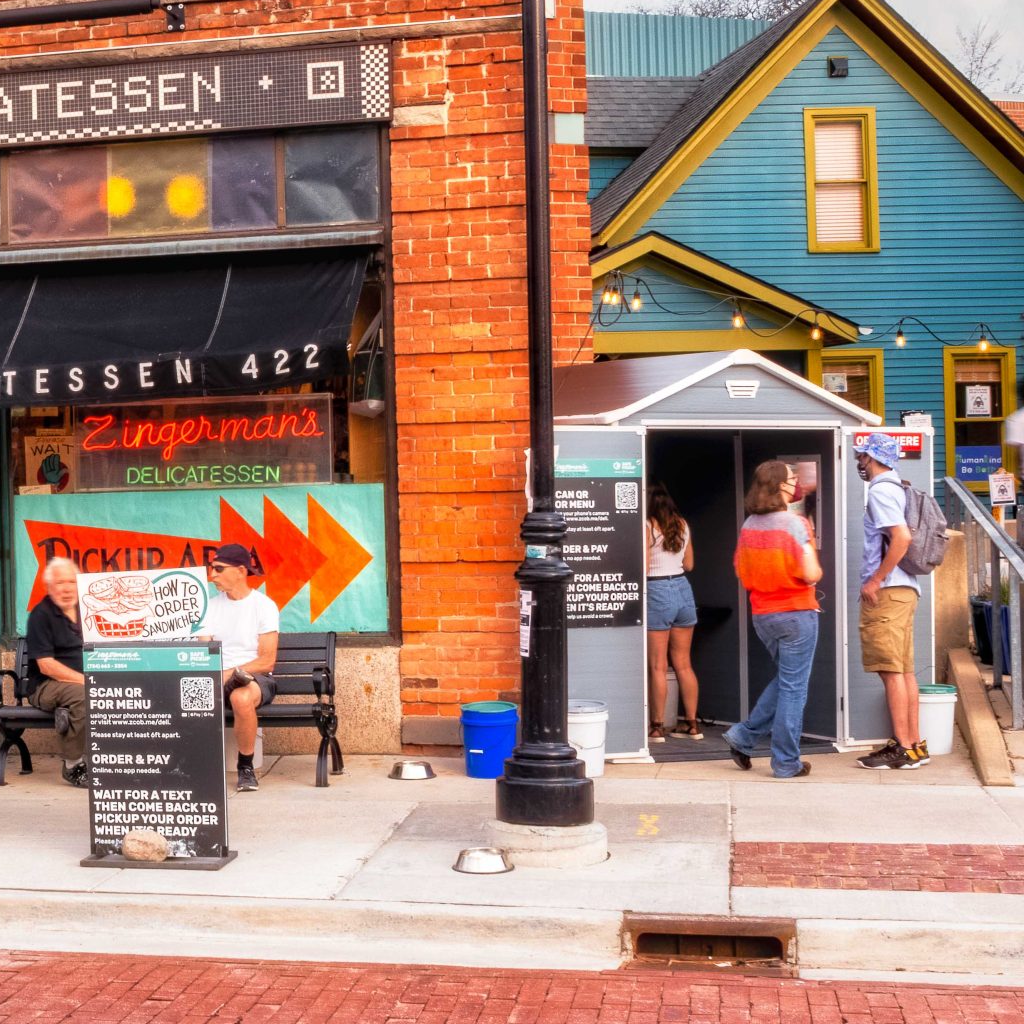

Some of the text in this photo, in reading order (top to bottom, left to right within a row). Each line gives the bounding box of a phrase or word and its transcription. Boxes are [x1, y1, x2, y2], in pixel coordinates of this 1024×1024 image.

[240, 342, 320, 380] 422
[82, 407, 324, 461] Zingerman's
[30, 443, 75, 457] WAIT
[126, 464, 281, 485] DELICATESSEN
[555, 490, 589, 500] CAN QR
[554, 500, 596, 509] OR MENU
[562, 544, 609, 554] DER & PAY
[179, 541, 266, 575] ARA
[573, 573, 623, 582] FOR A TEXT
[181, 581, 199, 597] TO
[576, 583, 602, 592] COME
[602, 583, 627, 591] BACK
[627, 582, 639, 591] TO
[566, 592, 639, 602] KUP YOUR ORDER
[154, 597, 199, 618] ORDER
[577, 603, 595, 612] IT'S
[595, 602, 625, 611] READY
[141, 611, 201, 638] SANDWICHES
[88, 676, 97, 685] 1.
[89, 687, 143, 699] SCAN QR
[89, 699, 152, 710] FOR MENU
[122, 712, 147, 720] phone's
[91, 742, 100, 751] 2.
[91, 754, 171, 765] ORDER & PAY
[92, 777, 102, 786] 3.
[93, 789, 193, 801] WAIT FOR A TEXT
[94, 801, 217, 813] THEN COME BACK TO
[94, 813, 219, 825] PICKUP YOUR ORDER
[94, 825, 130, 836] WHEN
[156, 826, 198, 837] READY
